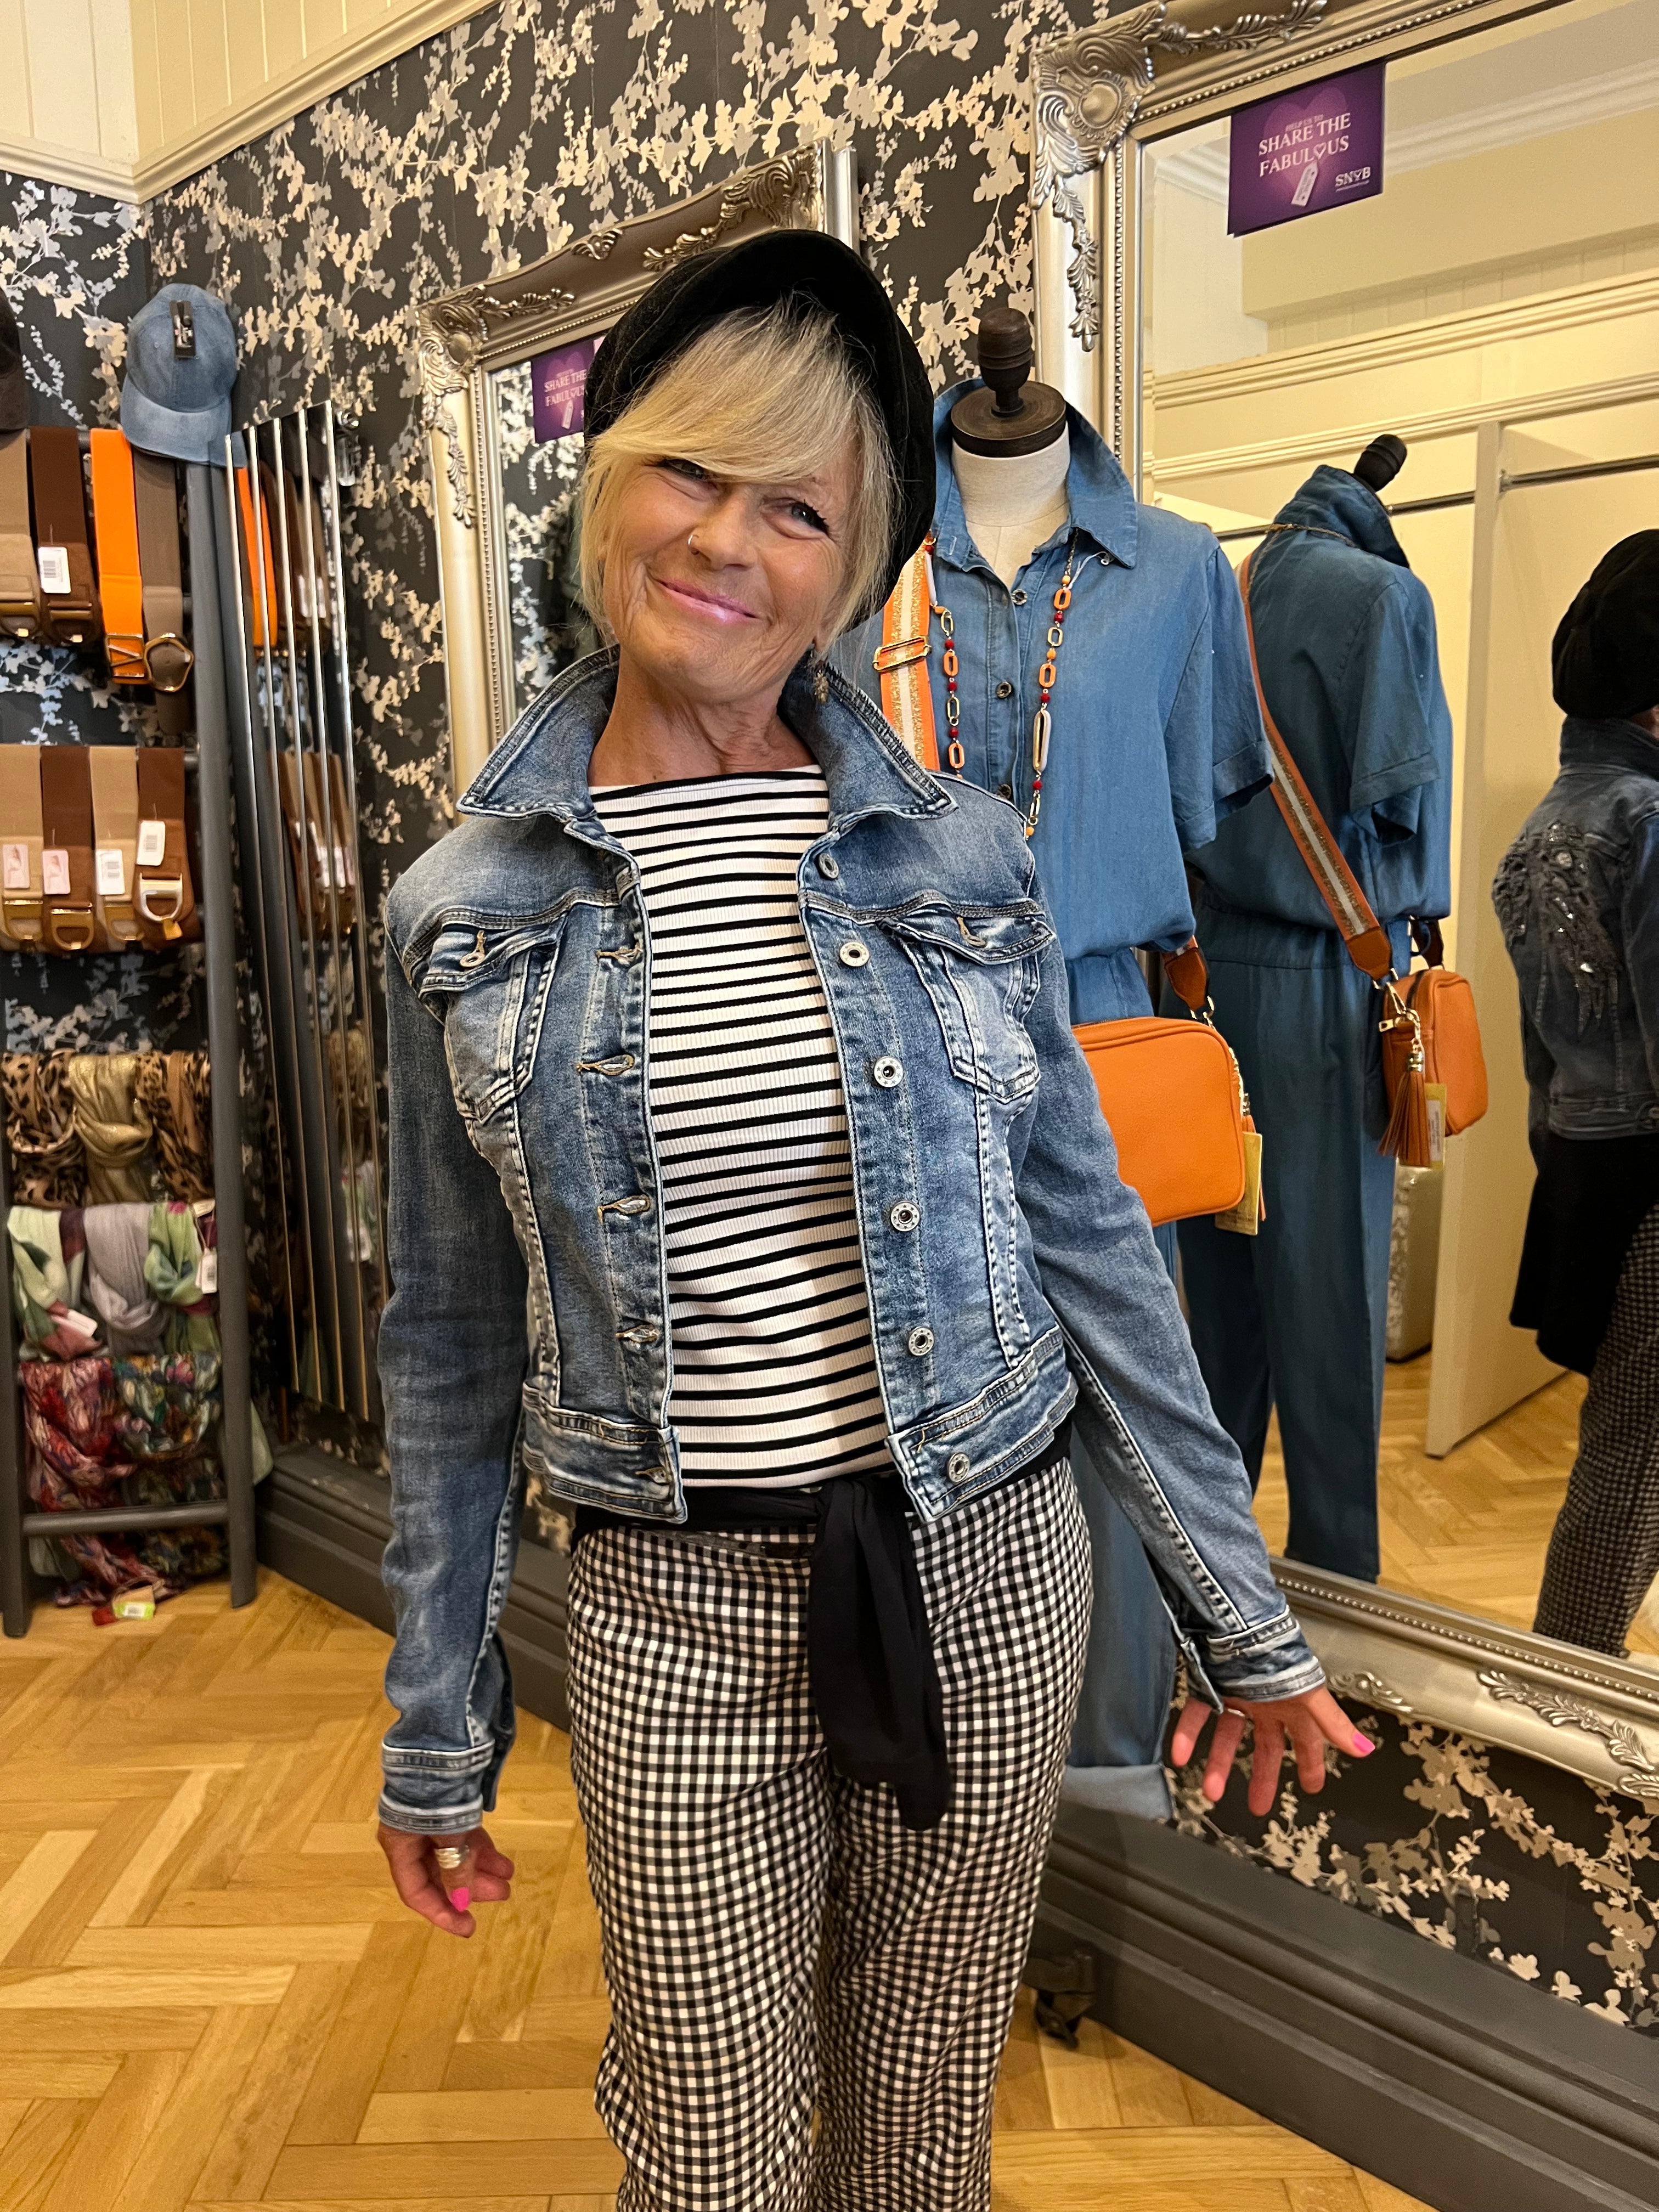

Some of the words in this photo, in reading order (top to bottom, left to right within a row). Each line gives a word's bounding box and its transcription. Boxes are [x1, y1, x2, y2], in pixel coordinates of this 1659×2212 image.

[1259, 125, 1313, 156] SHARE
[1317, 112, 1351, 137] THE
[544, 375, 570, 392] SHARE
